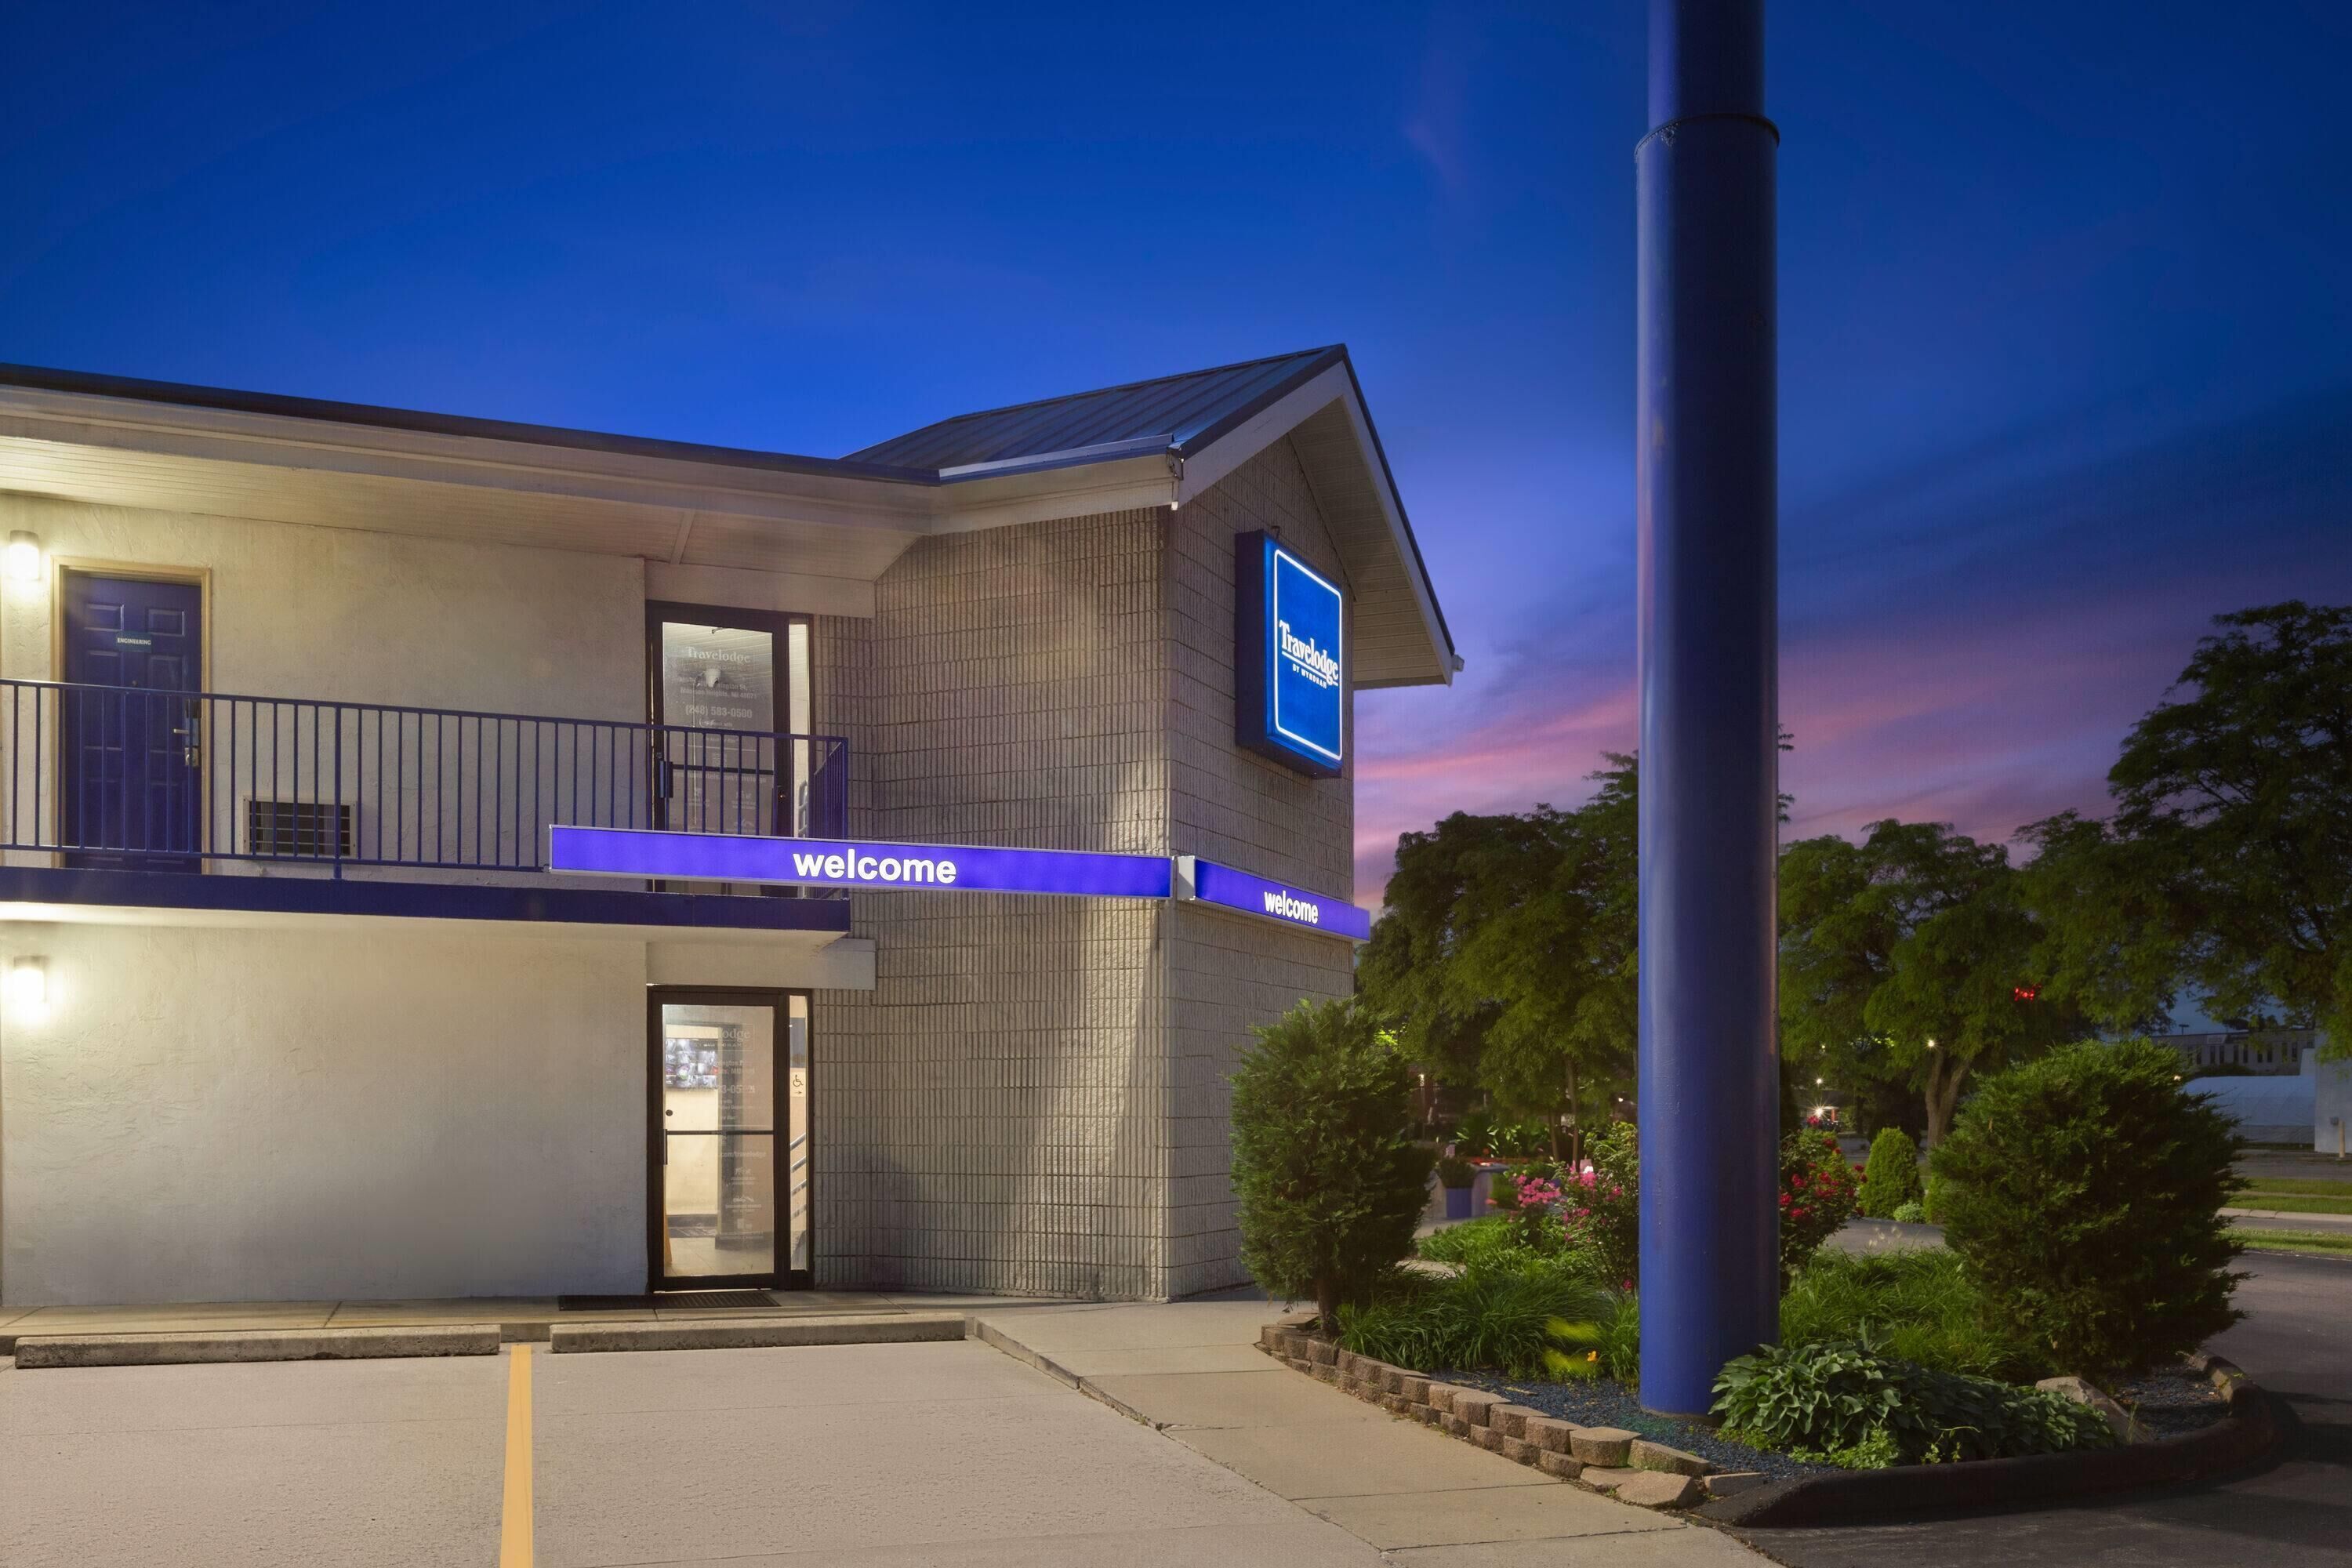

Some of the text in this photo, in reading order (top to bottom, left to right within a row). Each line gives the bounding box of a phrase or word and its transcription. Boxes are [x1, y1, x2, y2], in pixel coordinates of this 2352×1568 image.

[685, 646, 751, 666] Travelodge
[1279, 619, 1338, 686] Travelodge
[1292, 663, 1327, 689] BY WYNDHAM
[793, 848, 956, 884] welcome
[1264, 890, 1319, 924] welcome
